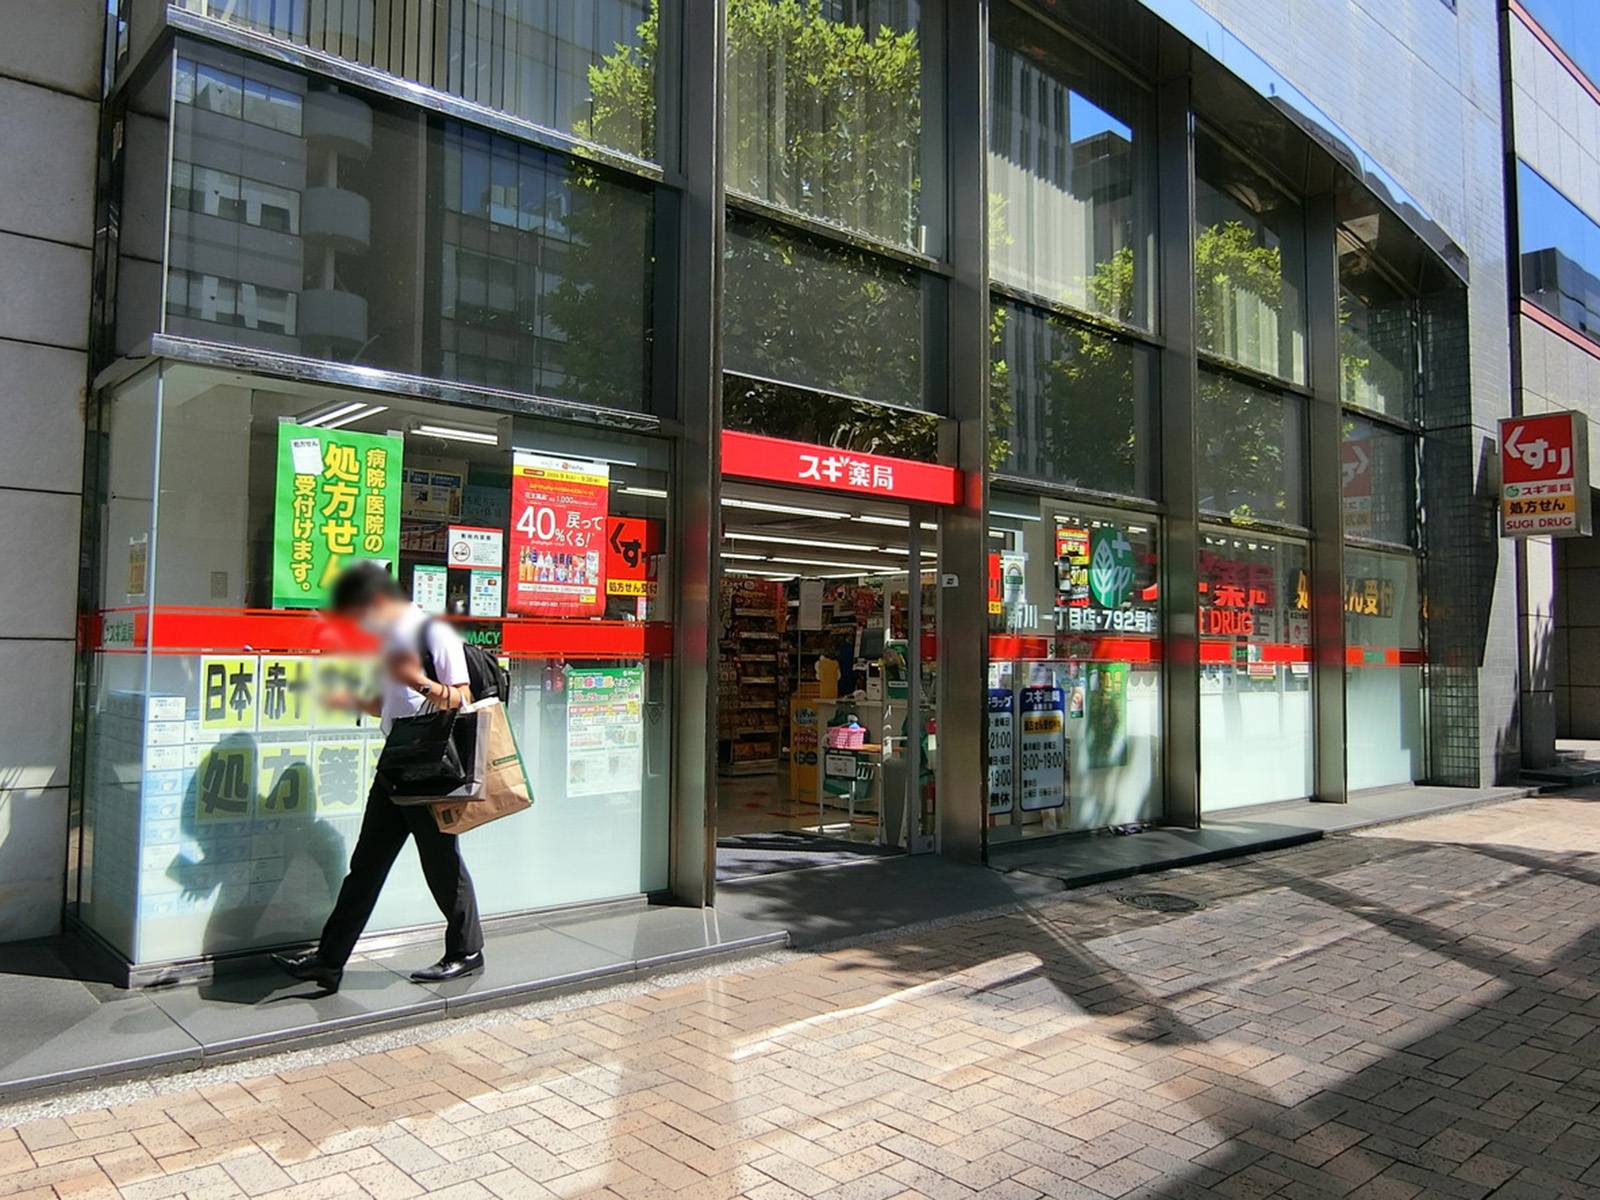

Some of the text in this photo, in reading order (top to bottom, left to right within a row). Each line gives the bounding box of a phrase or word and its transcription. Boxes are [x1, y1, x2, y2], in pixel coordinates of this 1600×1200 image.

[1503, 425, 1571, 475] くすり
[797, 454, 894, 491] スギ薬局
[363, 447, 387, 552] 病院・医院の
[1521, 483, 1571, 496] スギ薬局
[1509, 499, 1565, 515] 処方せん
[565, 510, 603, 531] 戻って
[1506, 516, 1572, 530] SUGI DRUG
[291, 474, 317, 592] 受付けます。
[608, 581, 658, 595] 処方せん受付
[1210, 610, 1254, 635] DRUG
[459, 630, 501, 645] MACY
[988, 717, 1011, 727] ・金曜日
[202, 747, 384, 814] 処方箋
